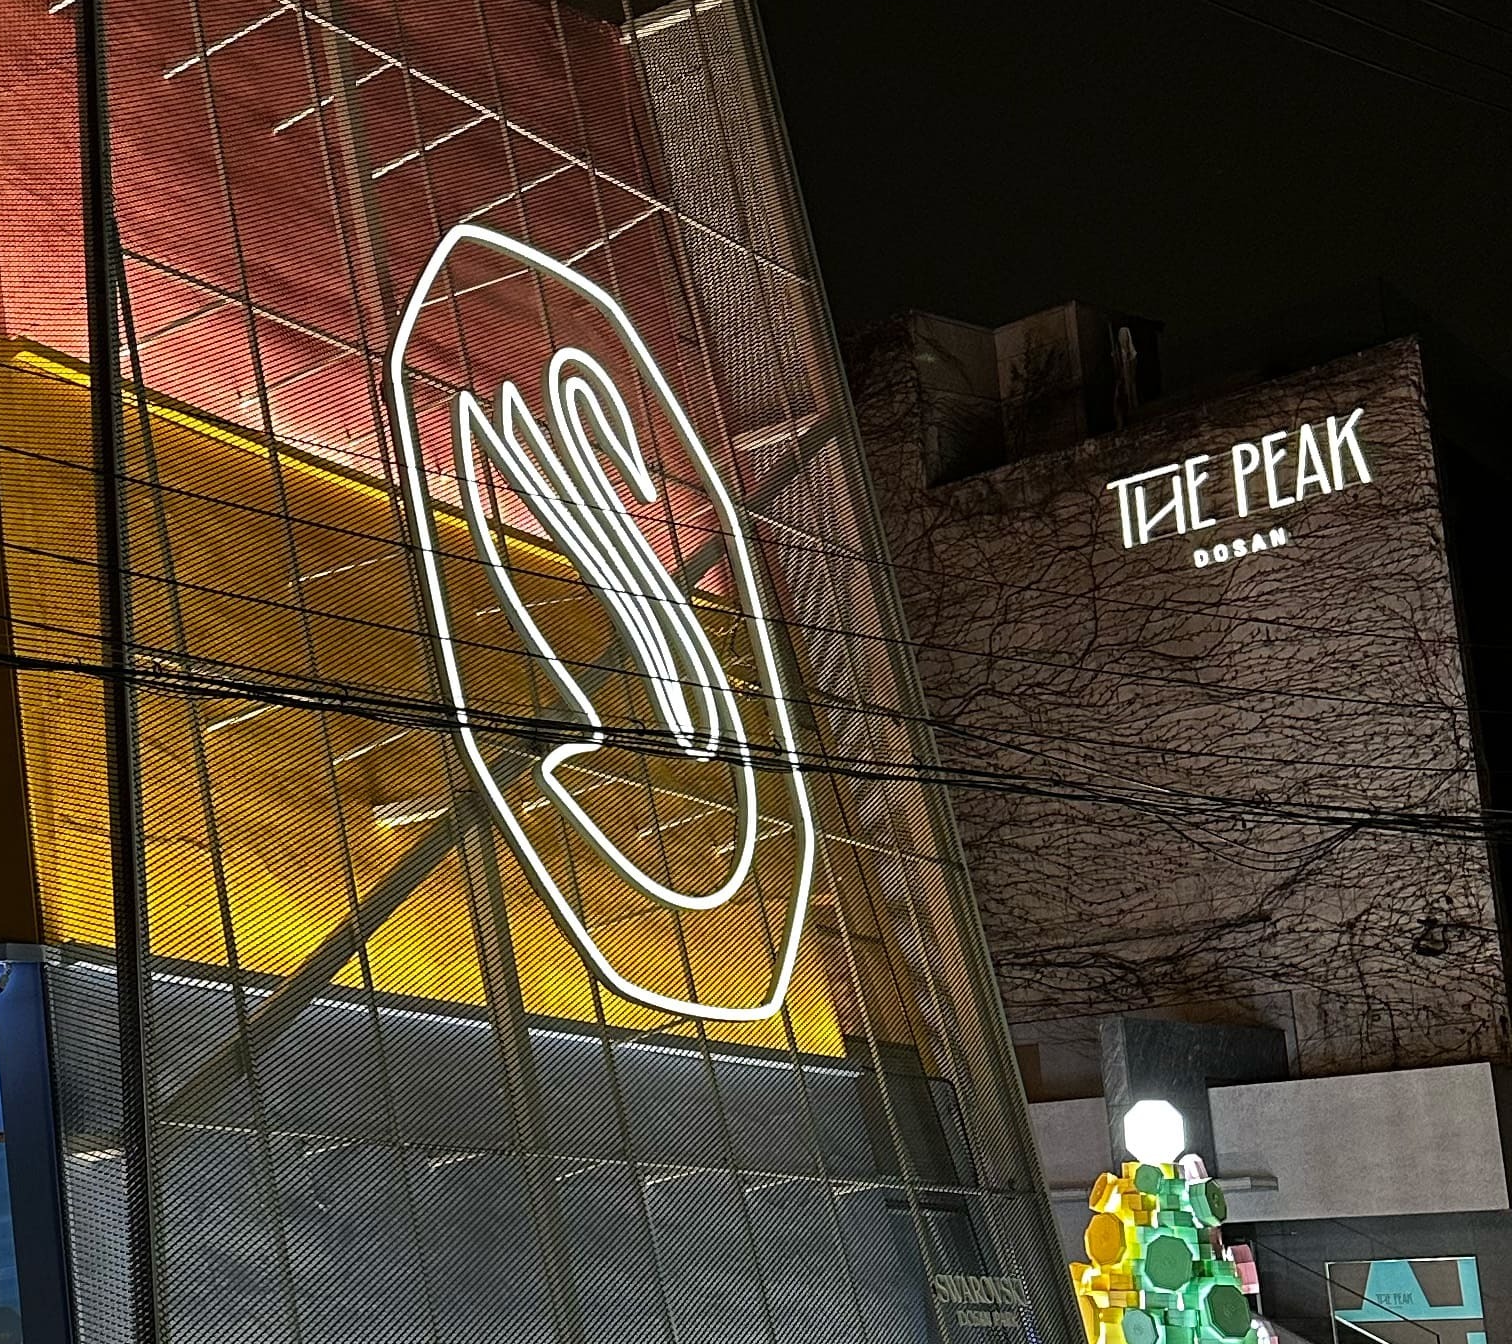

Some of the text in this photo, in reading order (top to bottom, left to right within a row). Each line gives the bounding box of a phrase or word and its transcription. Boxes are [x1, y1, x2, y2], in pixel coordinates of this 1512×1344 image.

[1106, 407, 1373, 549] THE PEAK
[1193, 527, 1287, 568] DOSAN
